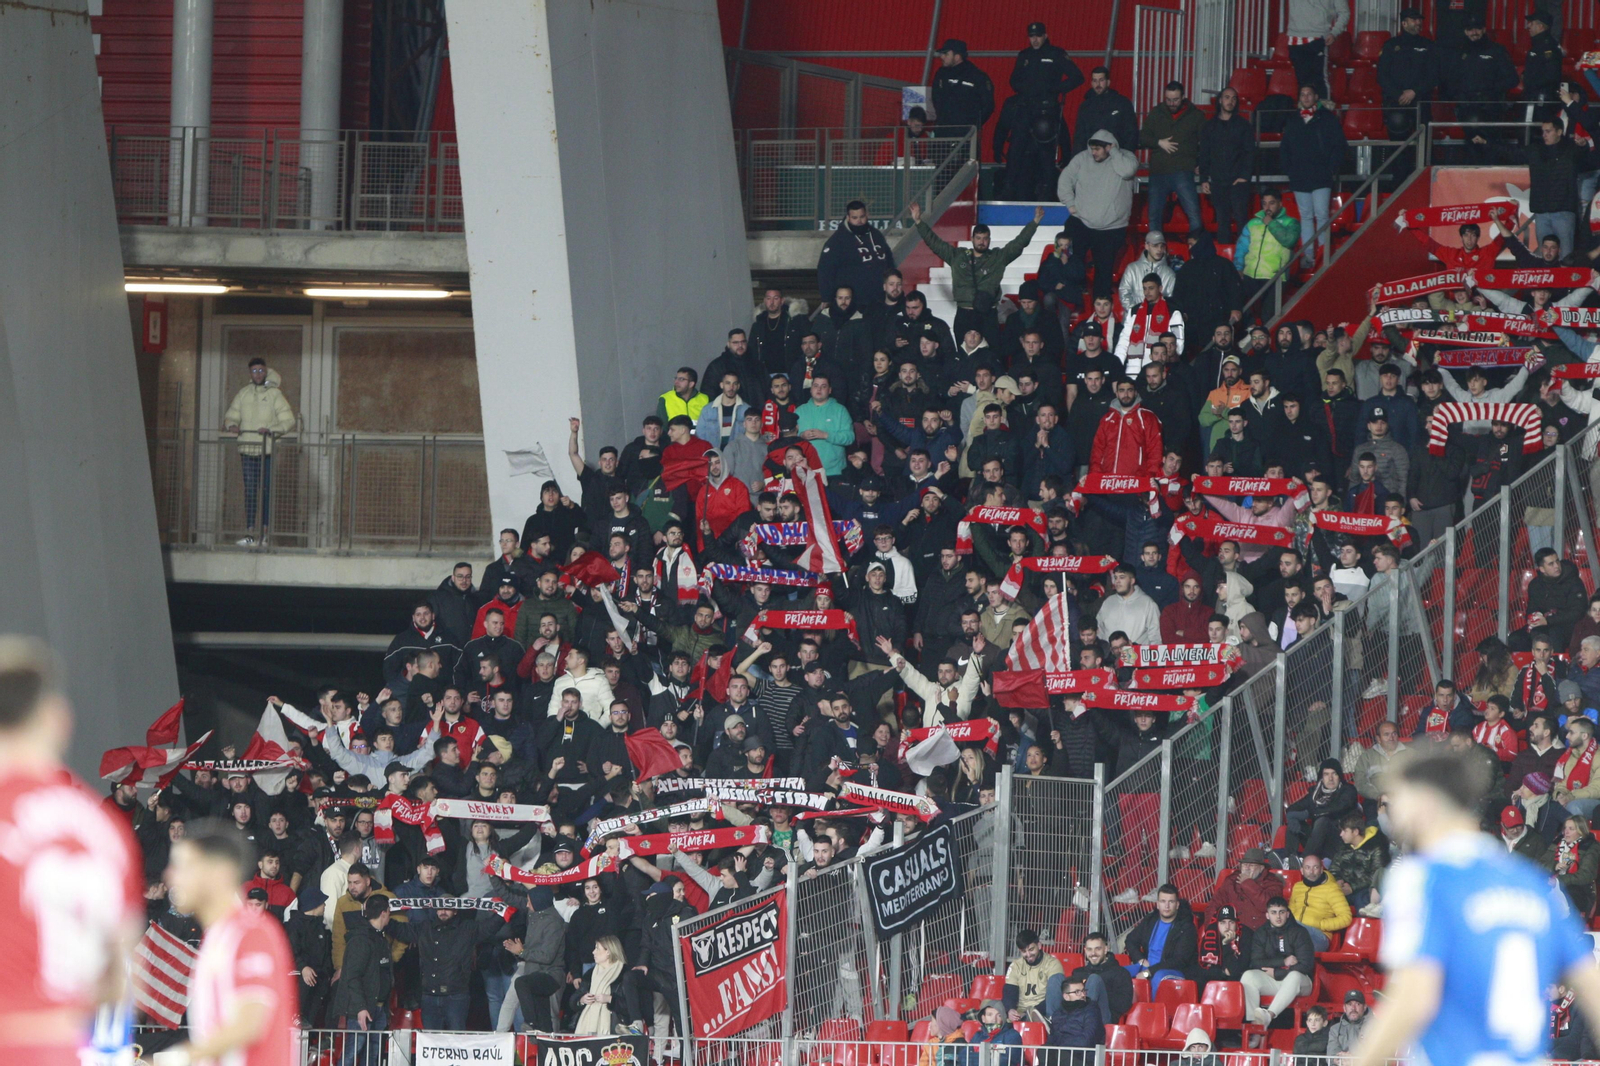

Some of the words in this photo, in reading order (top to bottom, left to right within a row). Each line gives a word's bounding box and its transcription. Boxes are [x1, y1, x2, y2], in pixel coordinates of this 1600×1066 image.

[1441, 209, 1481, 222] PRIMERA
[1512, 273, 1554, 286] PRIMERA
[1562, 310, 1580, 324] UD
[1582, 310, 1600, 324] AL
[1443, 330, 1494, 343] ALMERIA
[1100, 478, 1140, 490] PRIMERA
[1228, 480, 1270, 492] PRIMERA
[978, 508, 1020, 521] PRIMERA
[1322, 513, 1338, 524] UD
[1213, 526, 1258, 538] PRIMERA
[1036, 556, 1082, 568] PRIMERA
[785, 613, 828, 626] PRIMERA
[1142, 648, 1159, 662] UD
[1162, 647, 1216, 662] ALMERIA
[1046, 678, 1076, 690] RIMERA
[1162, 673, 1196, 685] PRIMERA
[1114, 694, 1158, 706] PRIMERA
[928, 726, 971, 738] PRMERA
[657, 778, 736, 794] ALMERIA
[774, 790, 829, 810] FIRM
[850, 786, 864, 801] UD
[868, 791, 916, 811] ALMERIA
[670, 834, 716, 848] PRIMERA
[879, 837, 947, 896] CASUALS
[390, 898, 507, 912] eriensistas
[716, 908, 778, 959] RESPECT
[422, 1046, 468, 1060] ETERNO
[472, 1044, 503, 1060] RAÚL
